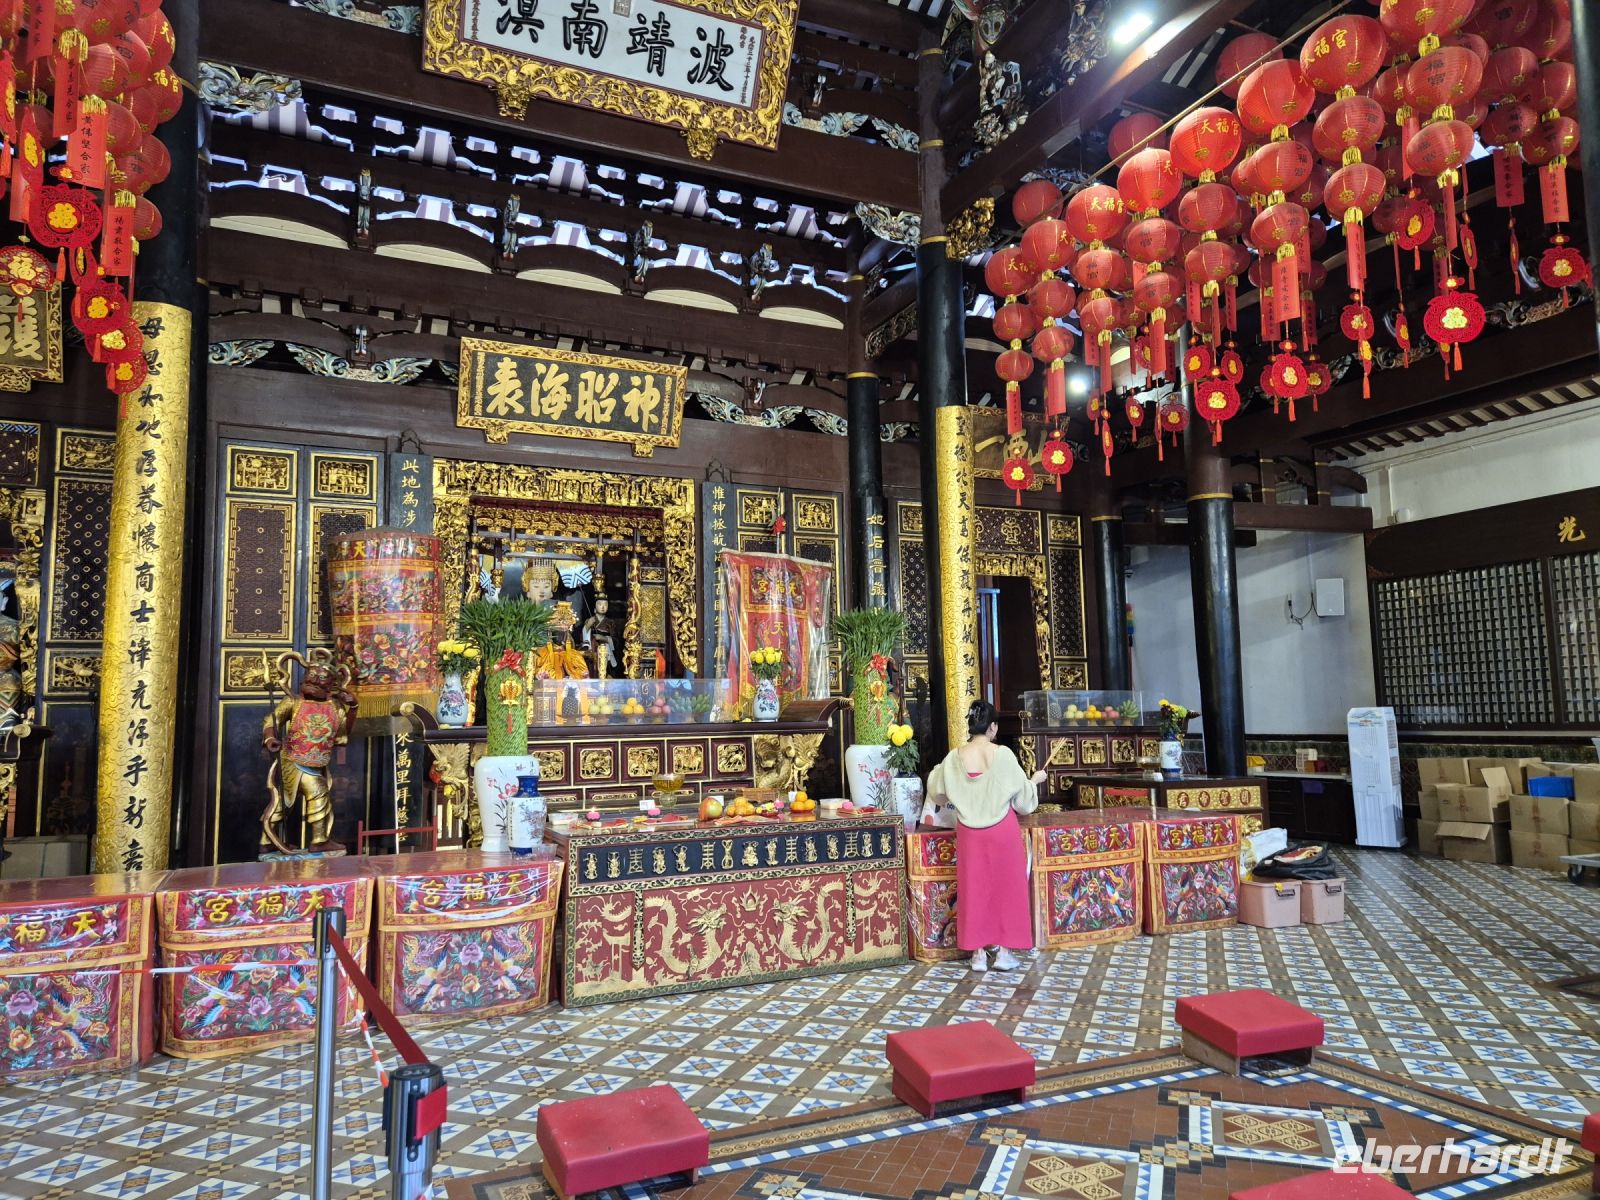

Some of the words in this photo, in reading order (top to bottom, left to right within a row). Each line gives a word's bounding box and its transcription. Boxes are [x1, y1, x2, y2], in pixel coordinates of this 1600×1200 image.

[496, 0, 735, 92] 波靖南溟
[1200, 118, 1240, 136] 天福宮
[1090, 196, 1126, 213] 天福宮
[486, 356, 662, 432] 神昭海表
[1557, 515, 1586, 543] 光
[1059, 827, 1122, 852] 天福宮
[1169, 823, 1227, 848] 天福宮
[421, 873, 524, 906] 天福宮
[206, 889, 326, 923] 天福宮
